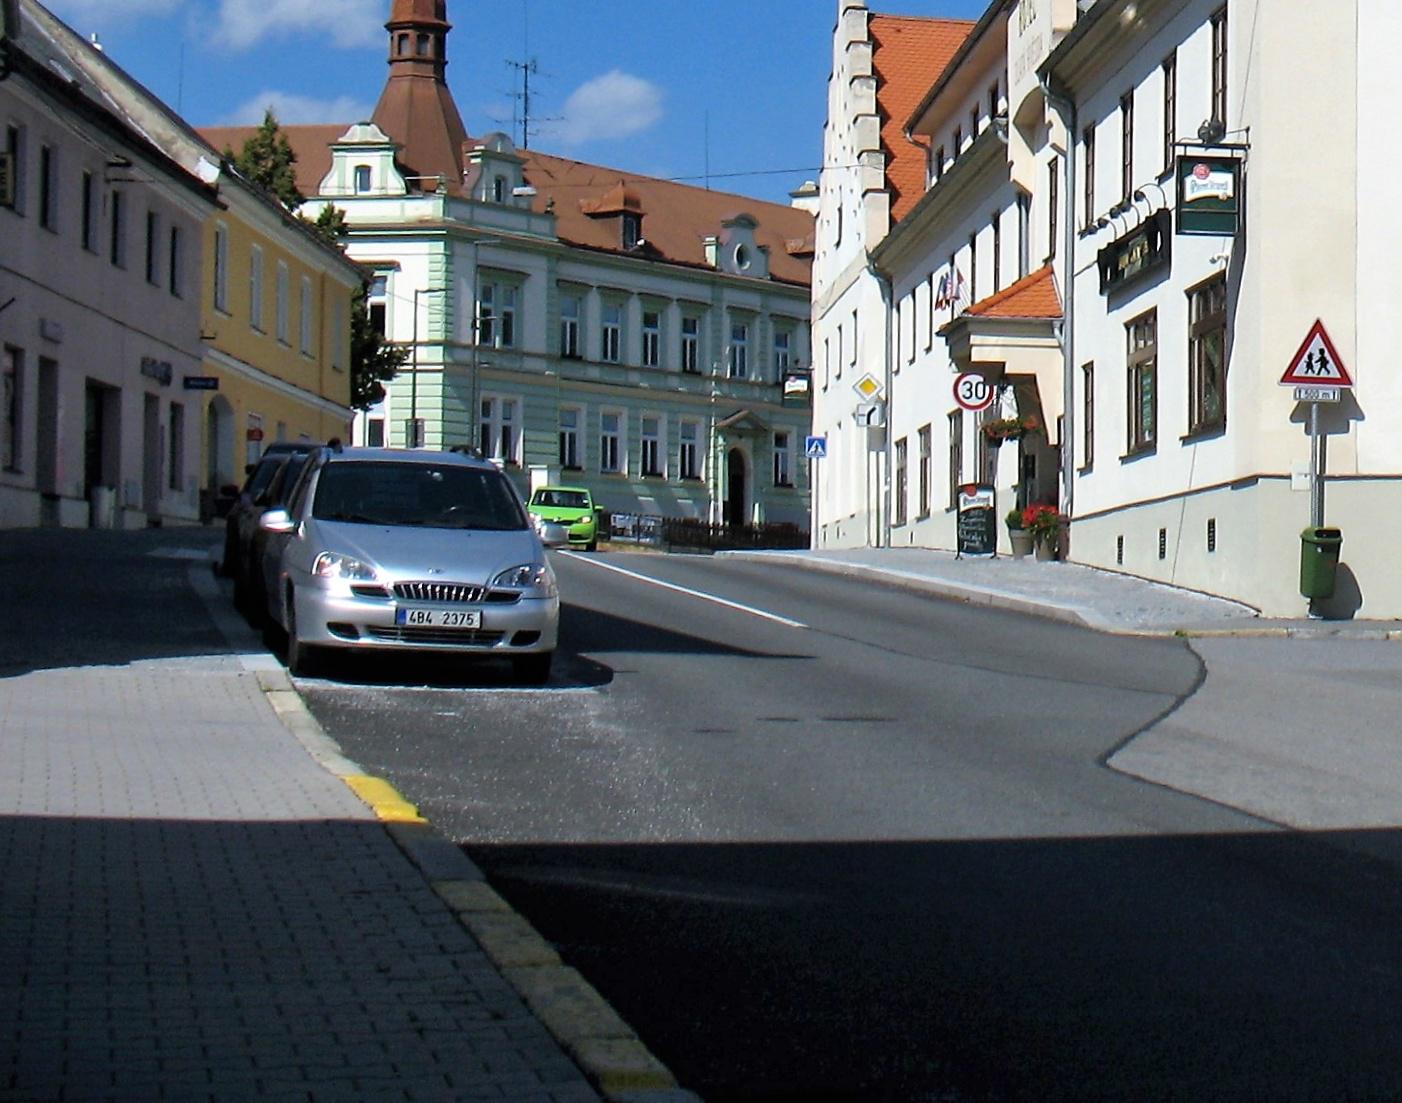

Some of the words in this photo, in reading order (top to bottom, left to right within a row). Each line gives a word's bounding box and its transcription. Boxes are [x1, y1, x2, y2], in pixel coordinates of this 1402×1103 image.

[962, 380, 986, 400] 30
[409, 610, 433, 624] 4B4
[443, 612, 475, 626] 2375
